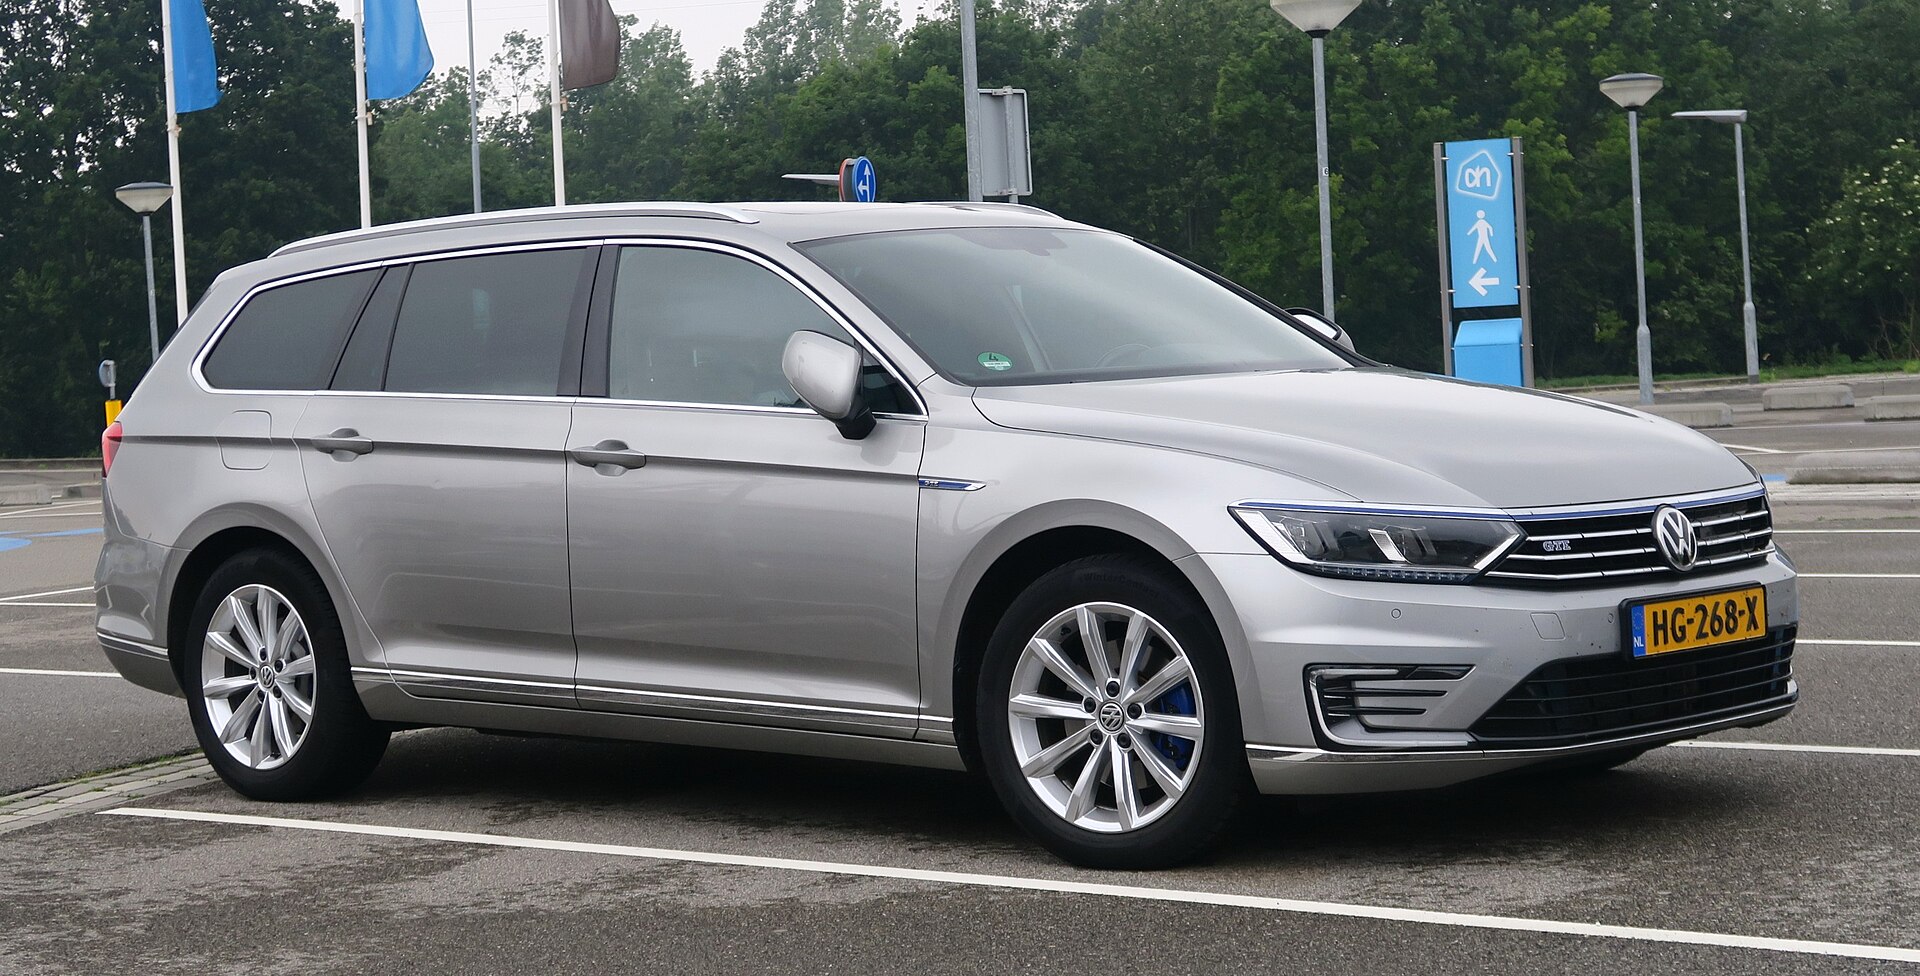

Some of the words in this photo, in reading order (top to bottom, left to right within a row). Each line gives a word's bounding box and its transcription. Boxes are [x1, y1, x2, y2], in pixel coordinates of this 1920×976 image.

[1542, 540, 1571, 551] GTE
[1652, 595, 1760, 647] HG-268-X
[1633, 636, 1645, 648] NL
